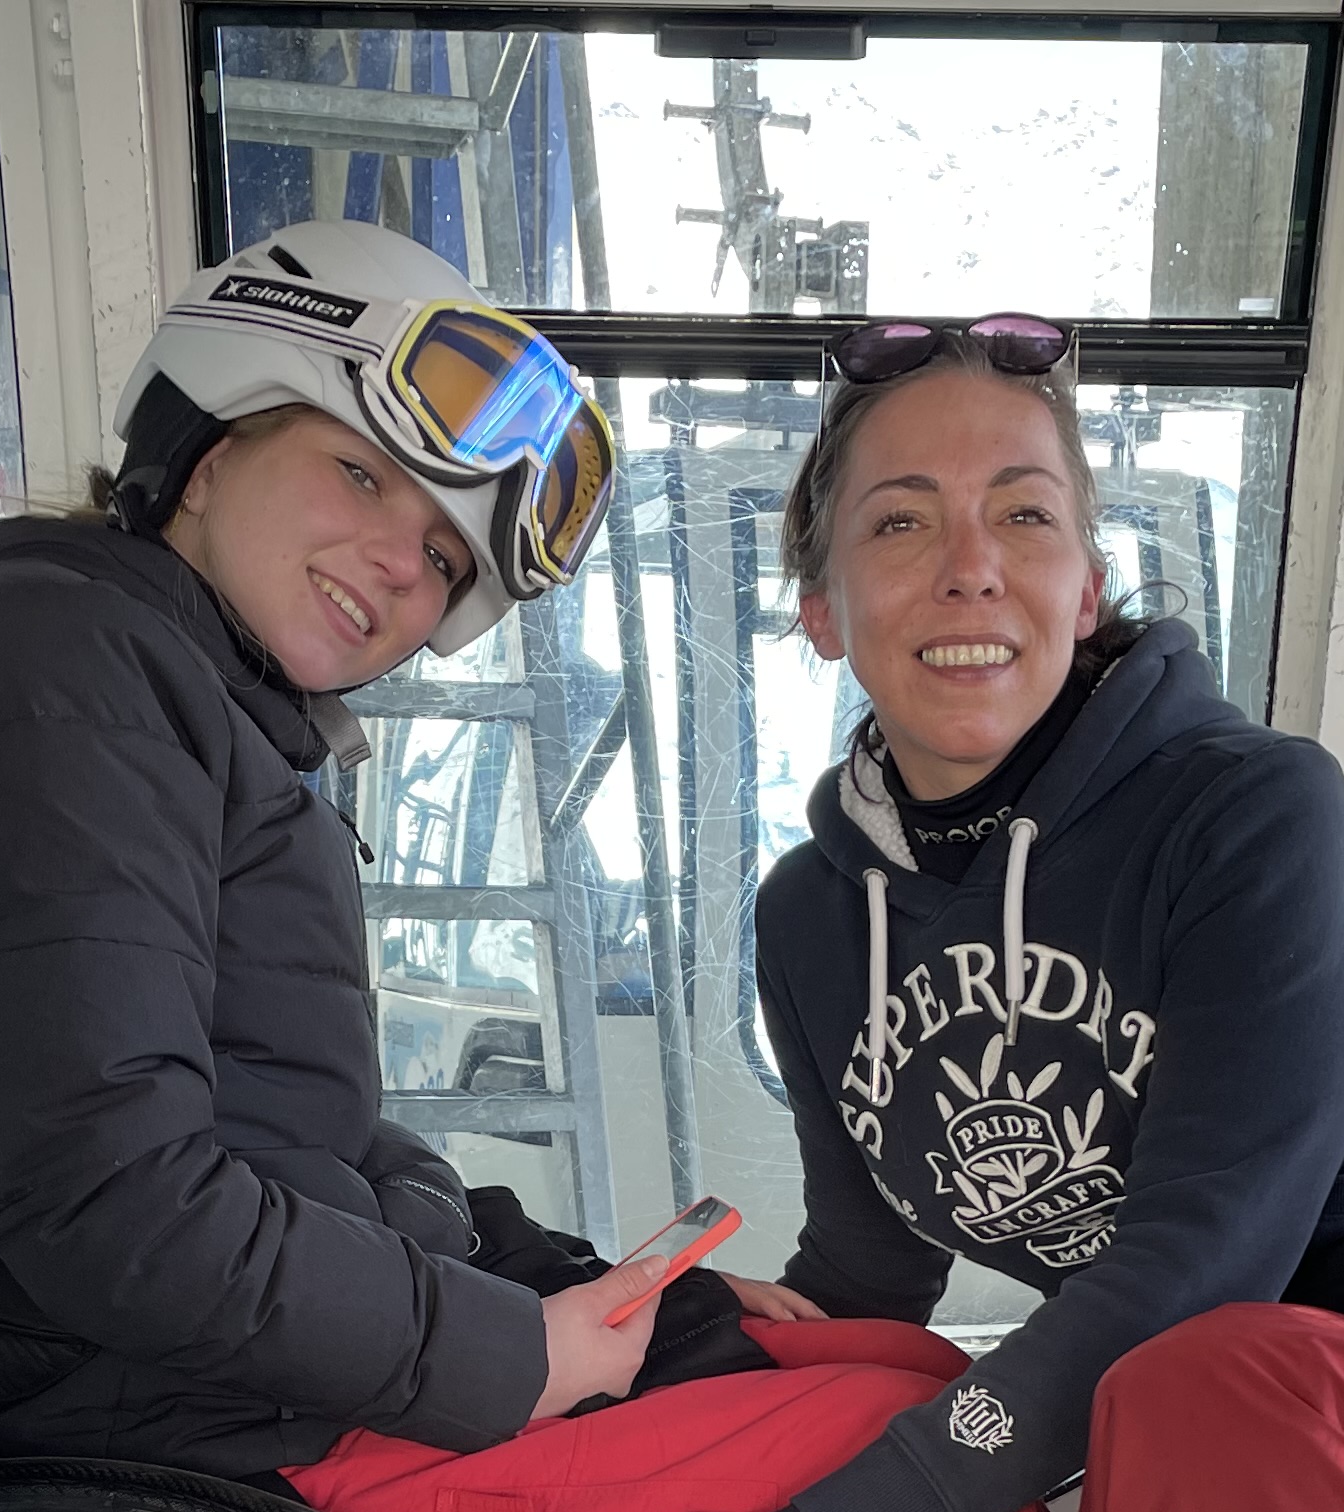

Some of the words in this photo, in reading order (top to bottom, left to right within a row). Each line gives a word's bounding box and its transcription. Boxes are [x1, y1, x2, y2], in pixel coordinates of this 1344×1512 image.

[838, 941, 1157, 1161] SUPERDRY
[956, 1114, 1044, 1153] PRIDE
[650, 1310, 737, 1356] erformance
